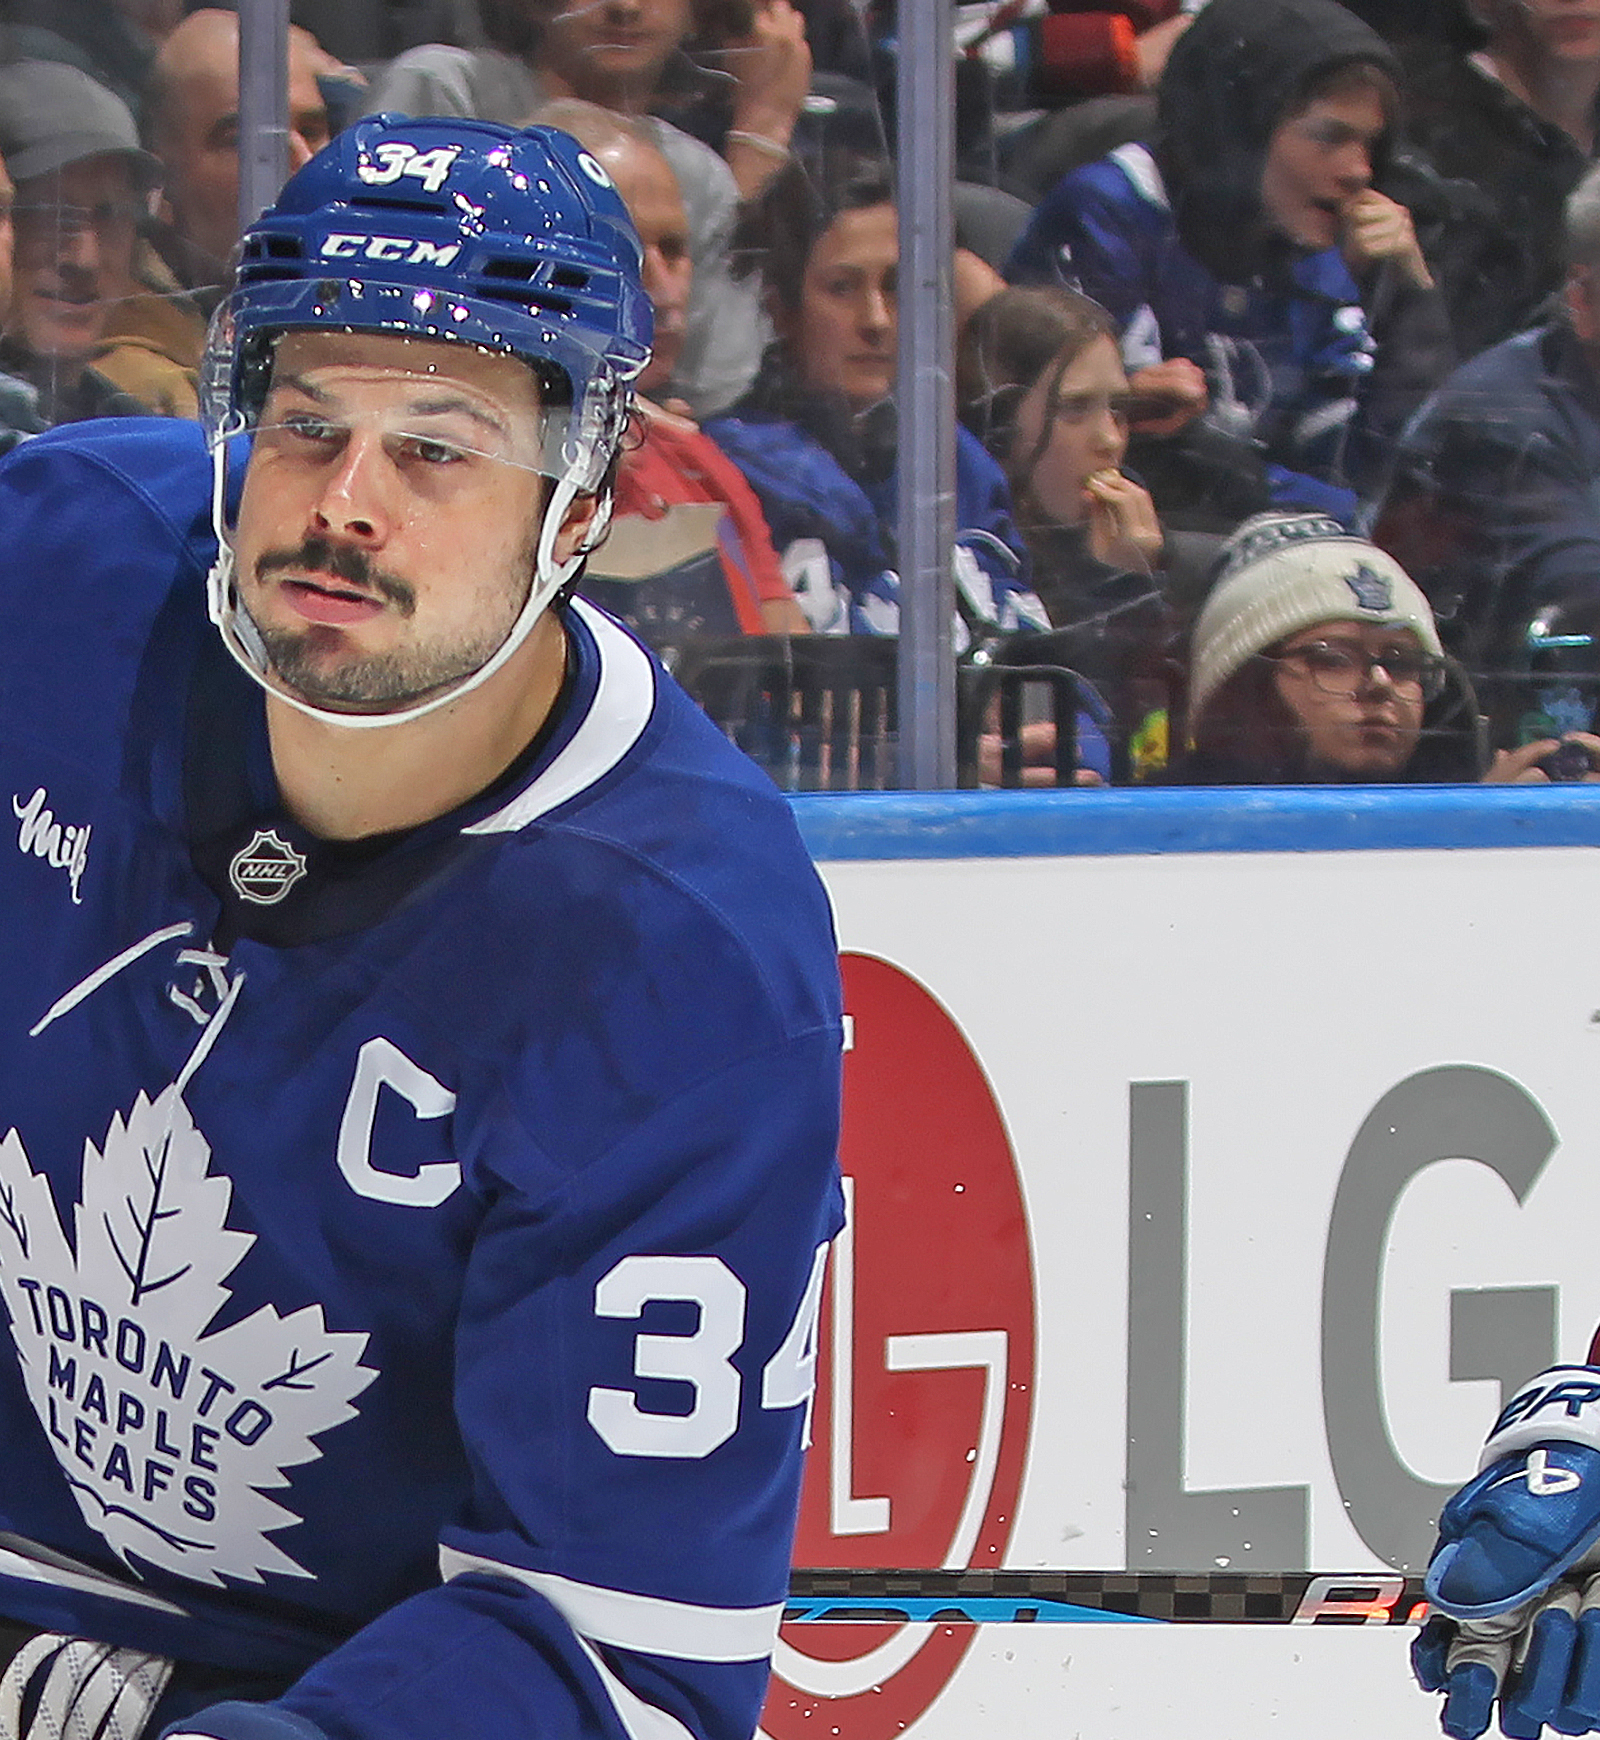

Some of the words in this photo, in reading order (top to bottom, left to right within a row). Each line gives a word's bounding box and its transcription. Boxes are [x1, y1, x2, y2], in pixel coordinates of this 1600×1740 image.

[357, 142, 461, 192] 34
[320, 232, 461, 267] CCM
[241, 863, 287, 877] NHL
[338, 1036, 463, 1208] C
[17, 1278, 273, 1447] TORONTO
[1126, 1063, 1562, 1573] LG
[49, 1343, 221, 1473] MAPLE
[49, 1395, 218, 1523] LEAFS
